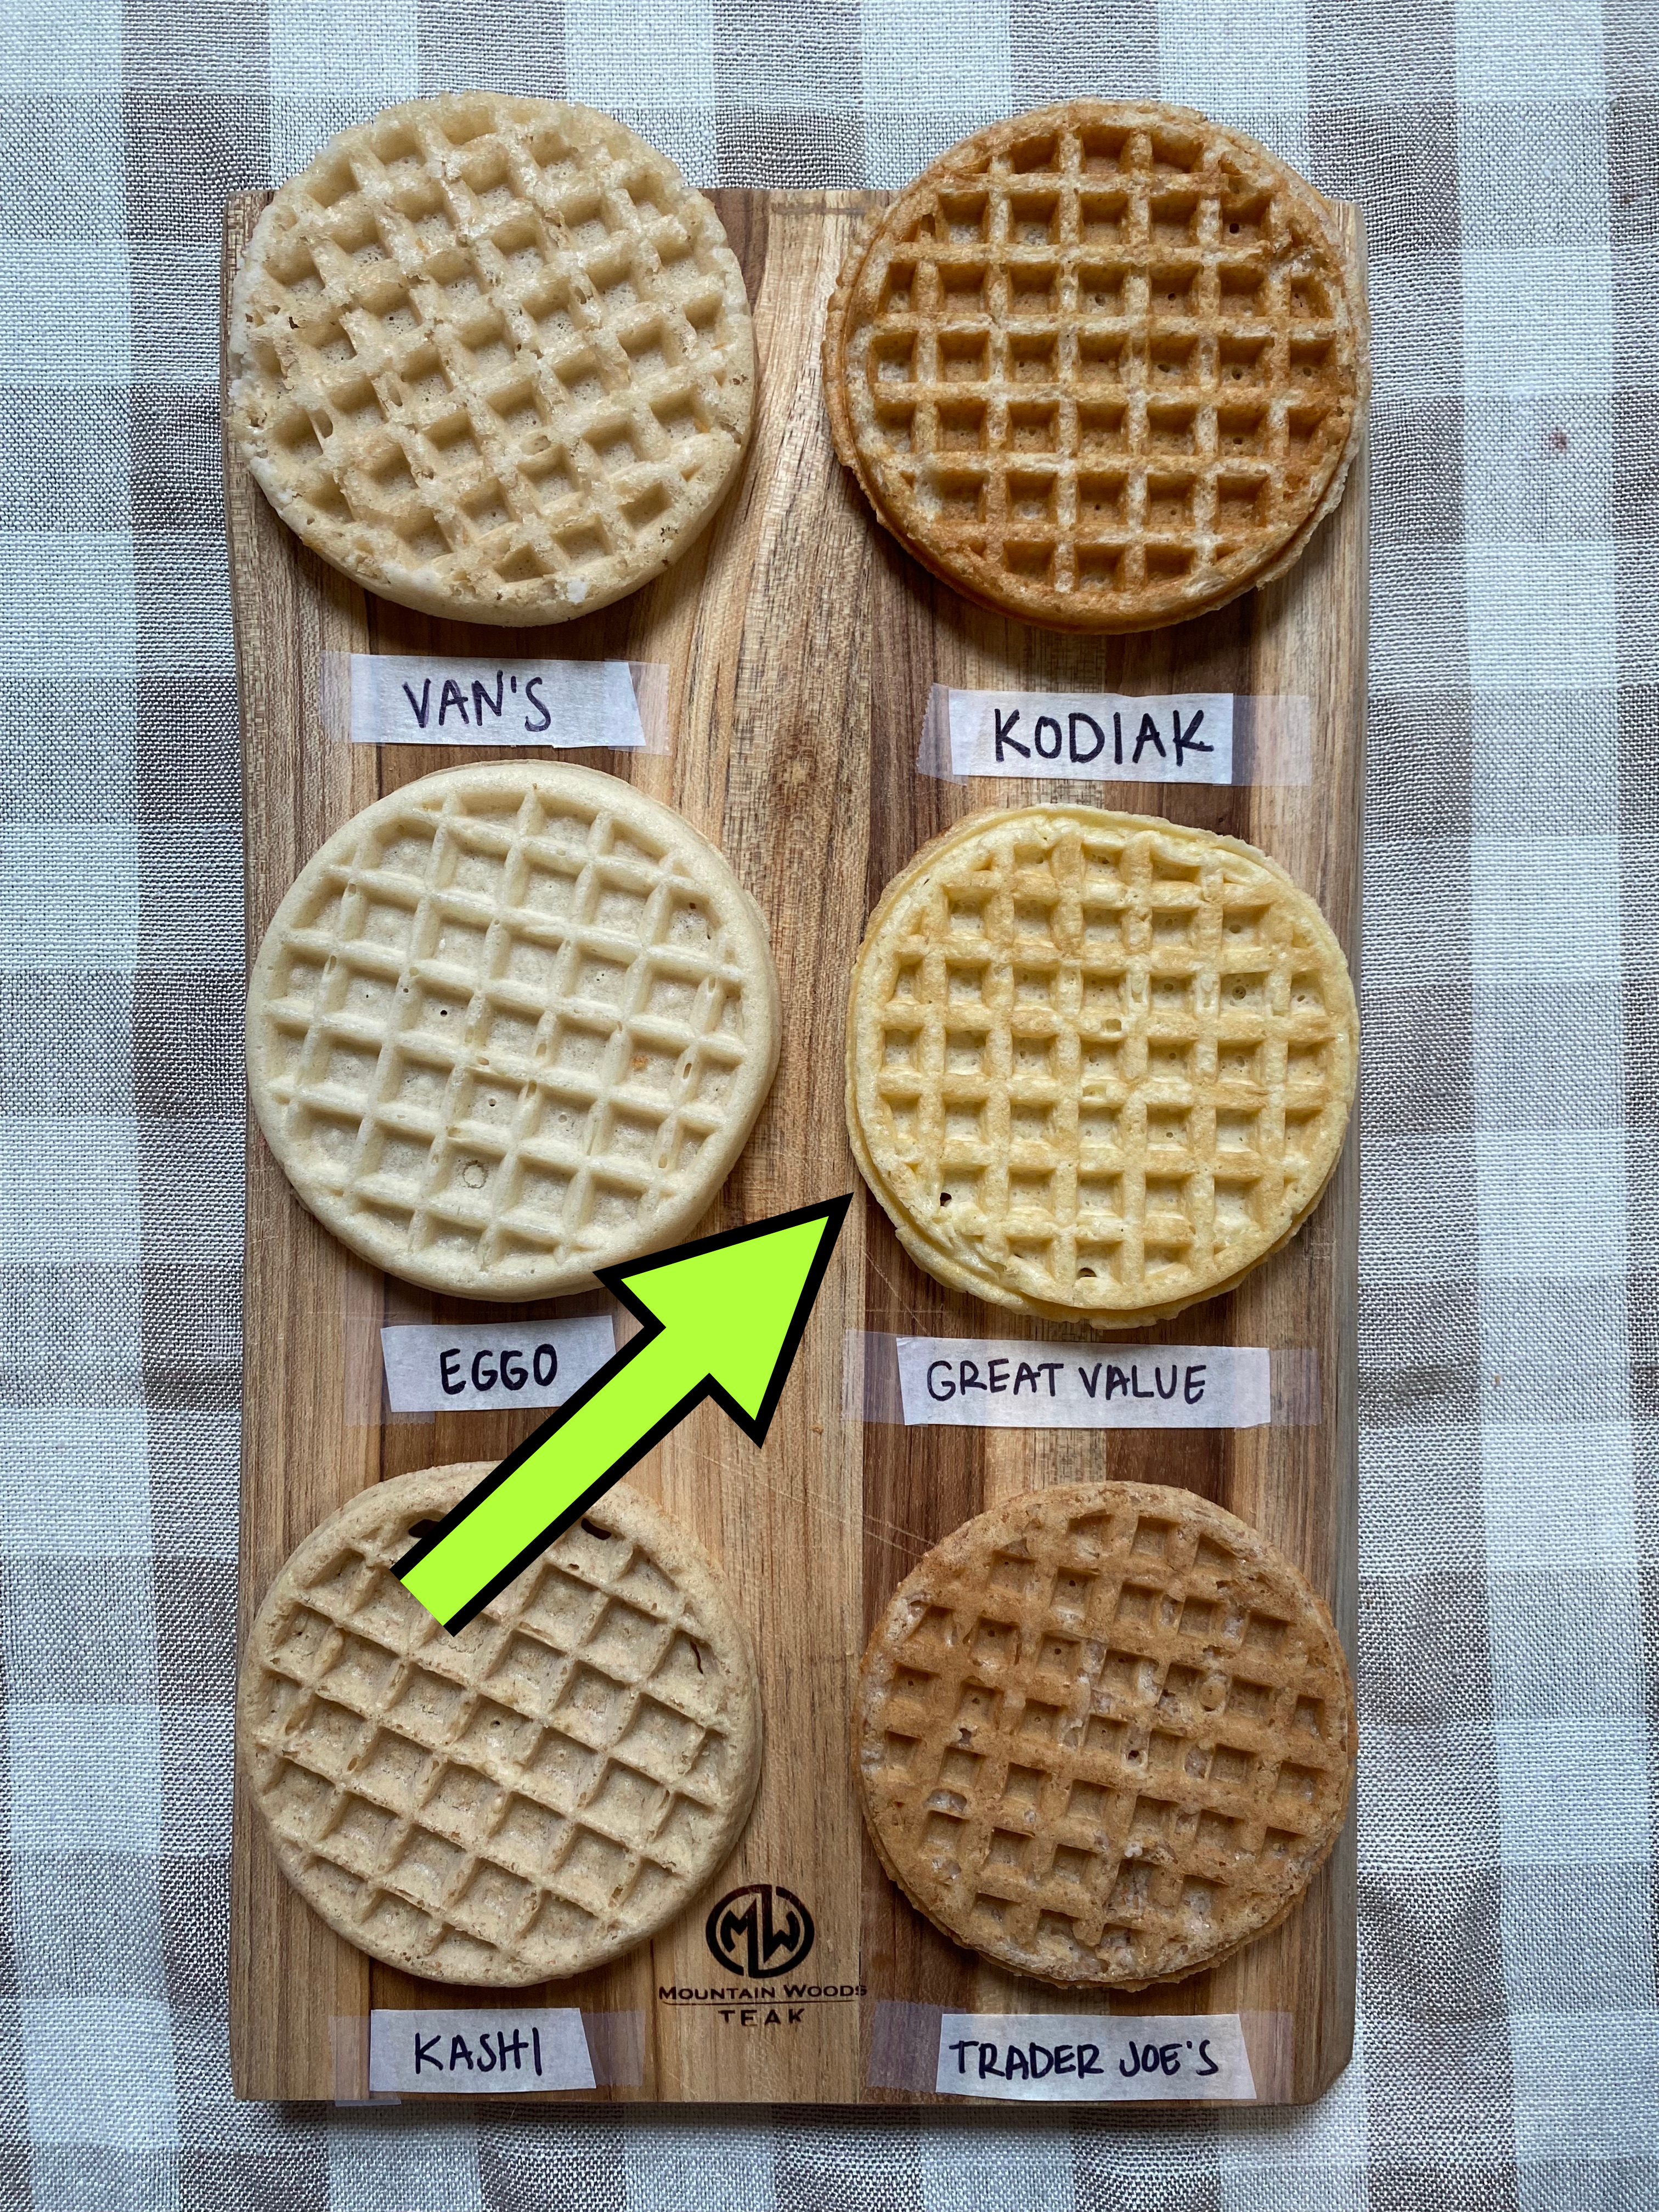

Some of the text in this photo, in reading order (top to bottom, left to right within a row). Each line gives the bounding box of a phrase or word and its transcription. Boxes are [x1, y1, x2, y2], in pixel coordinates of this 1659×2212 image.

[403, 670, 551, 731] VAN'S
[995, 709, 1214, 766] KODIAK
[440, 1344, 558, 1395] EGGO
[927, 1358, 1206, 1404] GREAT VALUE
[718, 2008, 805, 2026] TEAK
[414, 2027, 542, 2076] KASHI
[949, 2039, 1219, 2080] TRADER JOE'S
